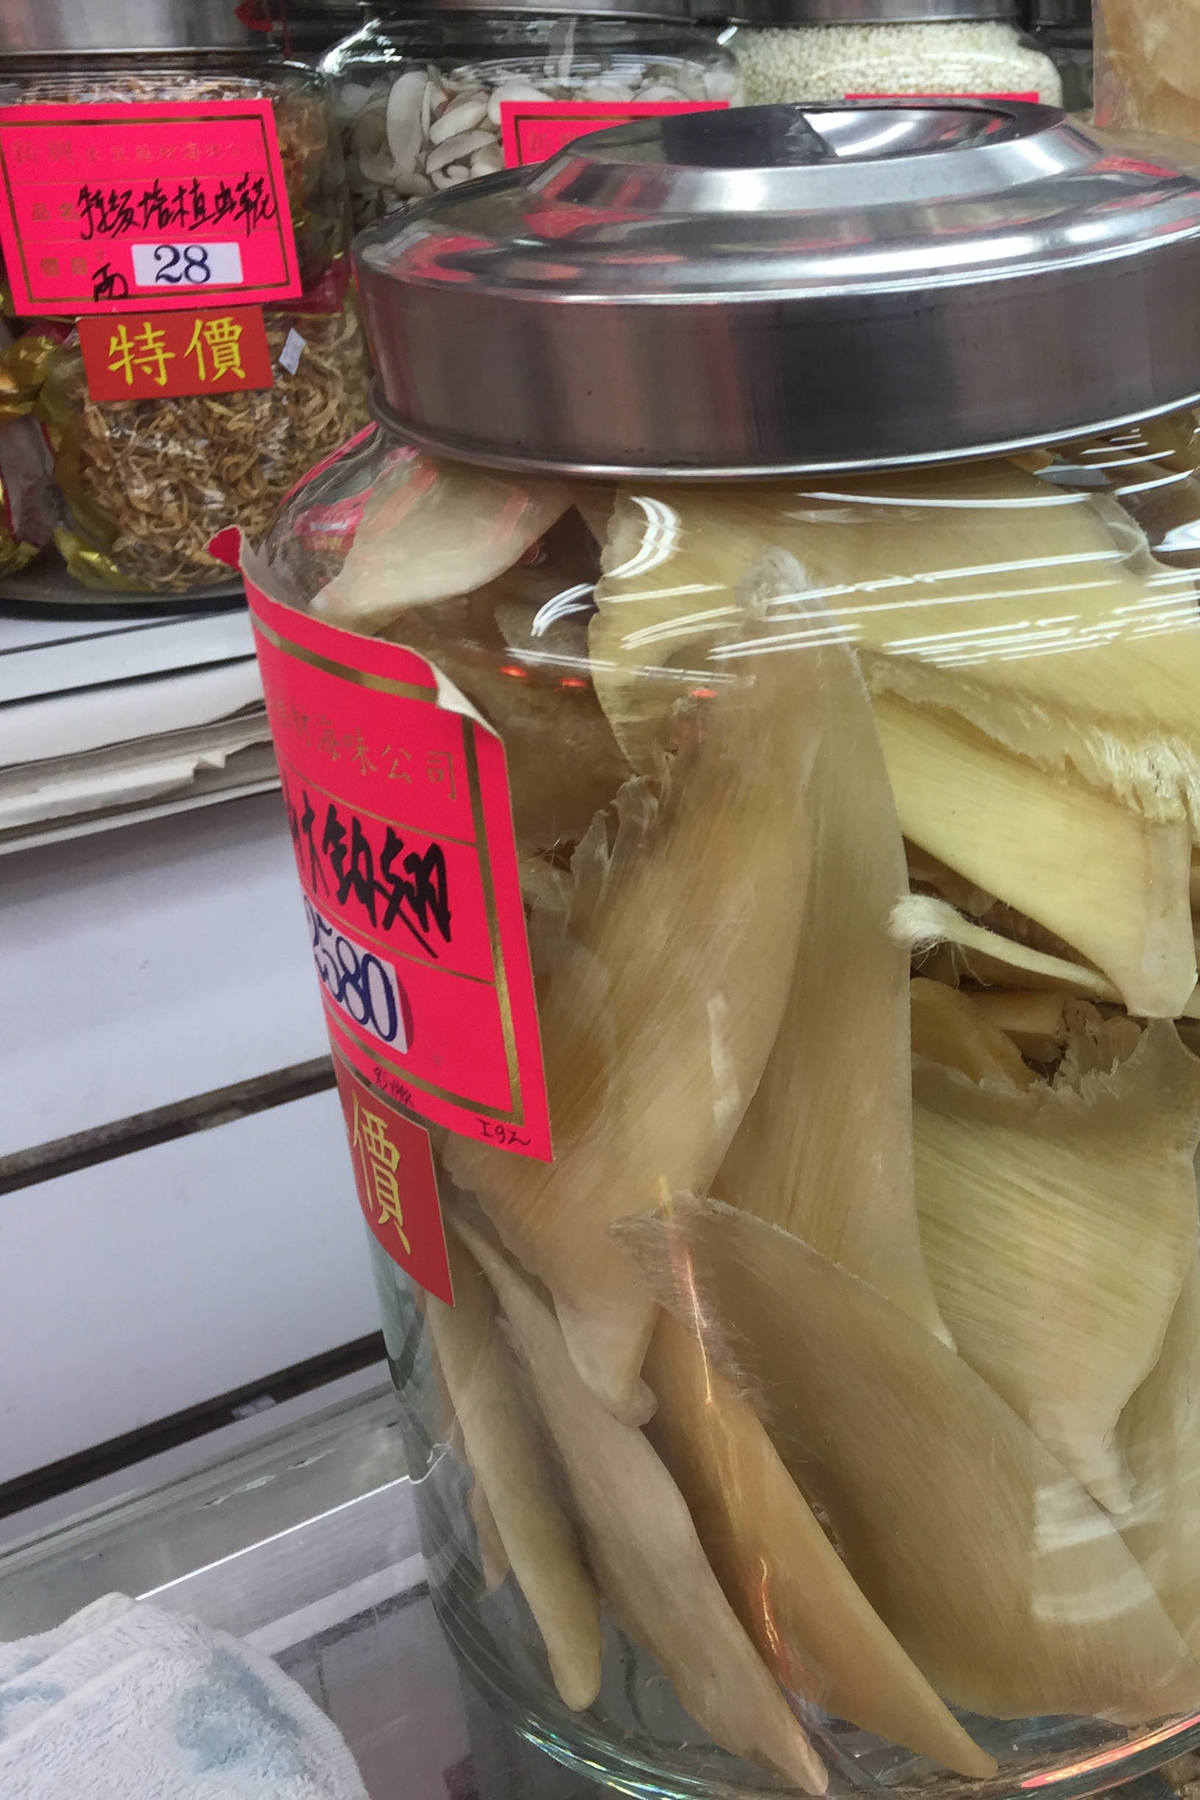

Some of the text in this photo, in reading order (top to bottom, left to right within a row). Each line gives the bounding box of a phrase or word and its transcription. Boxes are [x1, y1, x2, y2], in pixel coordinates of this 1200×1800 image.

[153, 244, 212, 285] 28
[107, 316, 246, 387] 特價
[350, 1088, 412, 1256] 價
